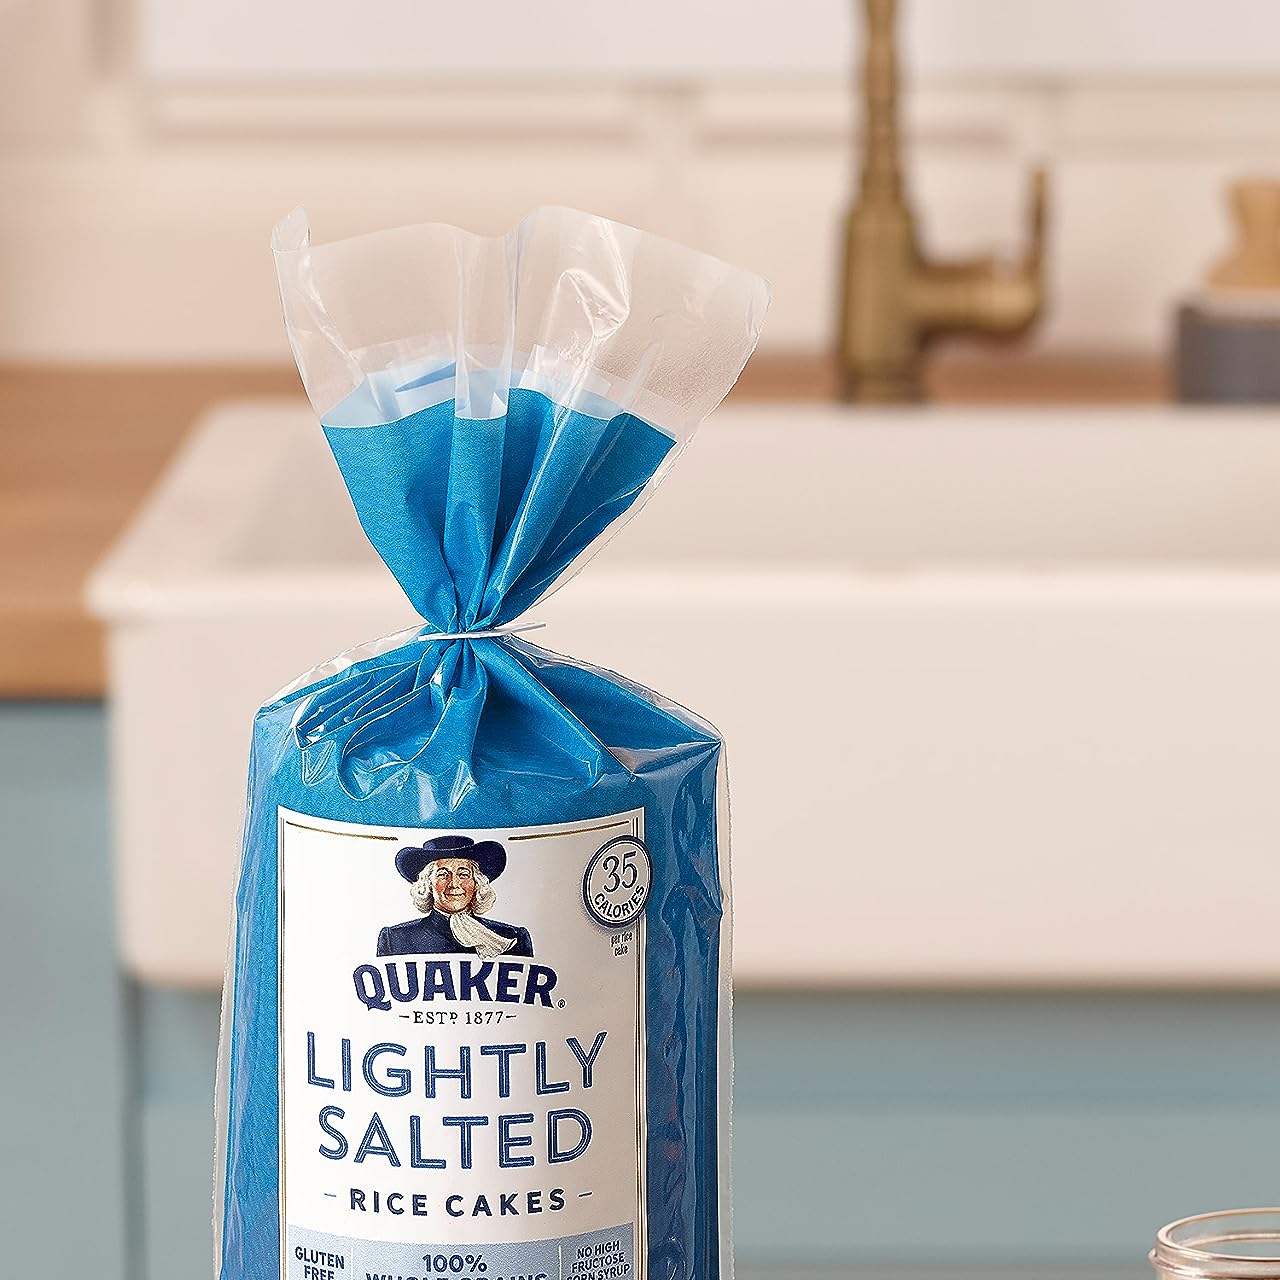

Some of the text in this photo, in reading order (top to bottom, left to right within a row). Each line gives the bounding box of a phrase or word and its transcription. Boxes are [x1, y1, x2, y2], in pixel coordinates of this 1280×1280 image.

[602, 850, 638, 893] 35
[594, 885, 645, 918] CALORIES
[353, 961, 558, 1012] QUAKER
[307, 1031, 608, 1099] LIGHTLY
[318, 1105, 594, 1170] SALTED
[350, 1188, 567, 1218] RICE CAKES
[295, 1246, 345, 1271] GLUTEN
[422, 1254, 488, 1274] 100%
[572, 1252, 625, 1273] FRUCTOSE
[577, 1240, 620, 1260] NO HIGH
[597, 1263, 631, 1280] SYRUP
